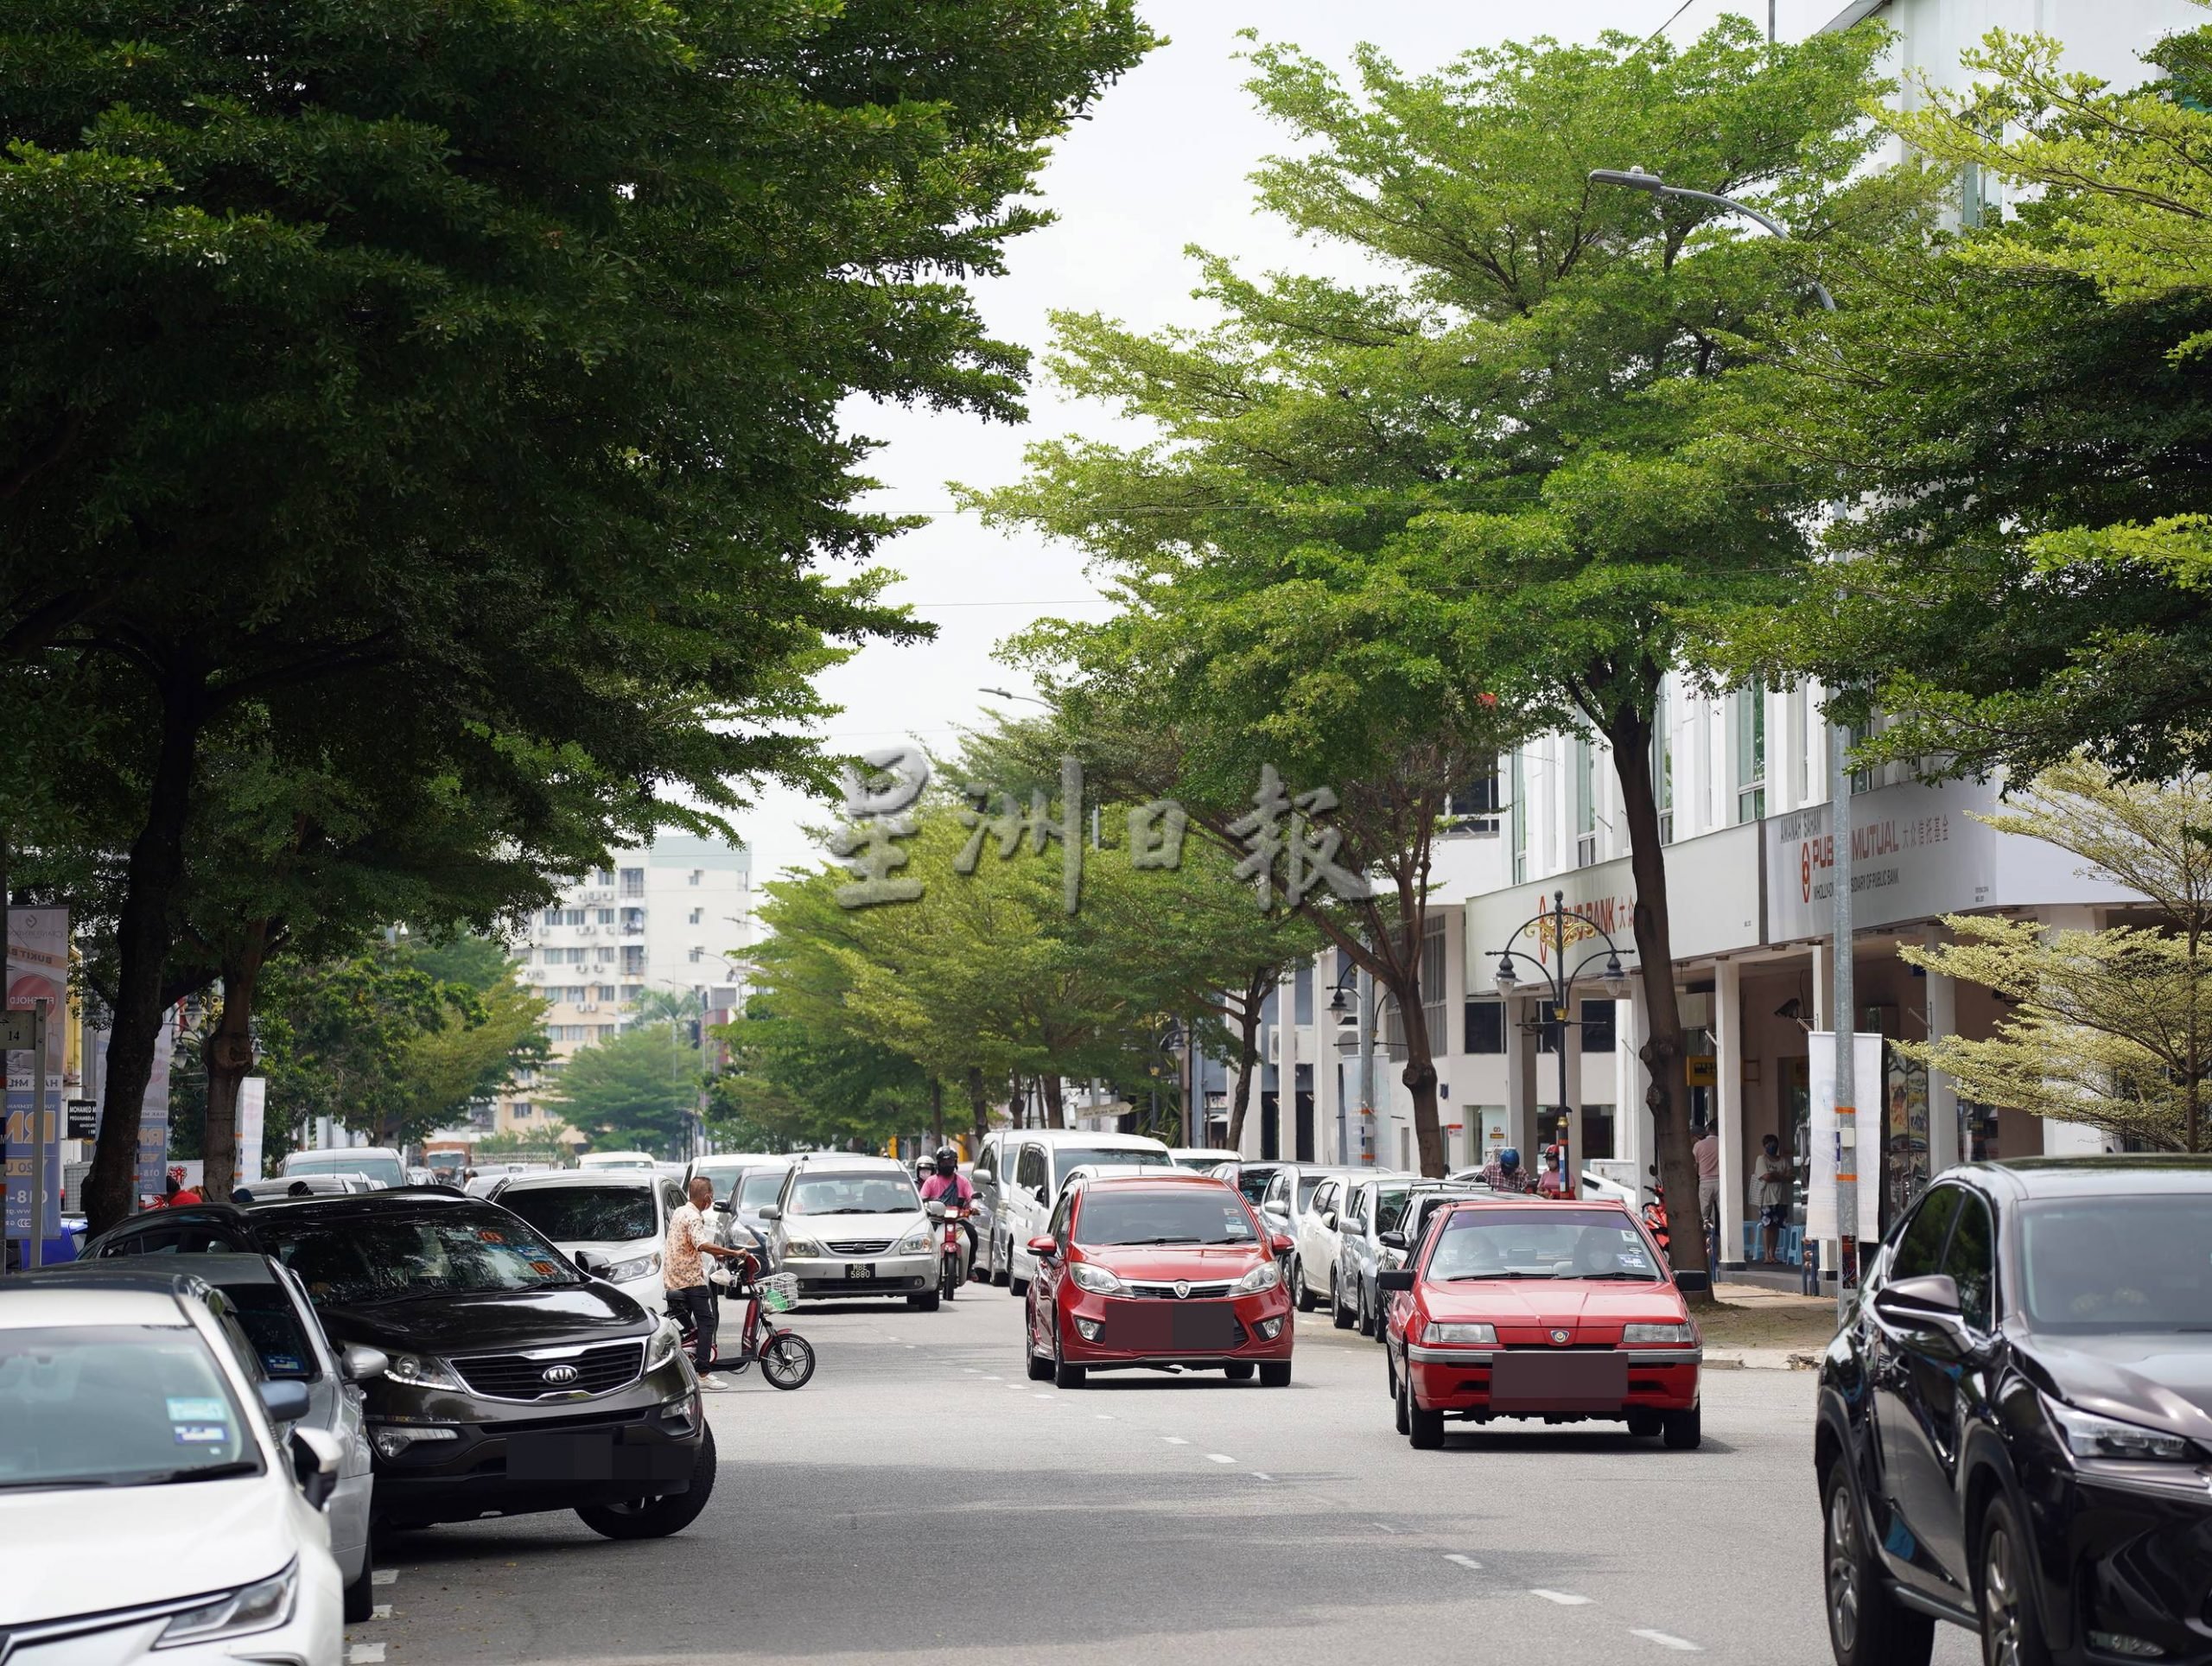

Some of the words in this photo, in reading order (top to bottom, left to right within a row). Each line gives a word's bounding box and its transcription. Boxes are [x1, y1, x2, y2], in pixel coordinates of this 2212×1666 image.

[1781, 814, 1802, 843] AMANAH
[1813, 836, 1834, 871] PUB
[1852, 819, 1899, 862] MUTUAL
[1850, 874, 1867, 893] SIDIARY
[1586, 897, 1616, 938] BANK
[8, 1031, 20, 1040] 14
[850, 1270, 870, 1279] 5880
[549, 1368, 574, 1382] KIA
